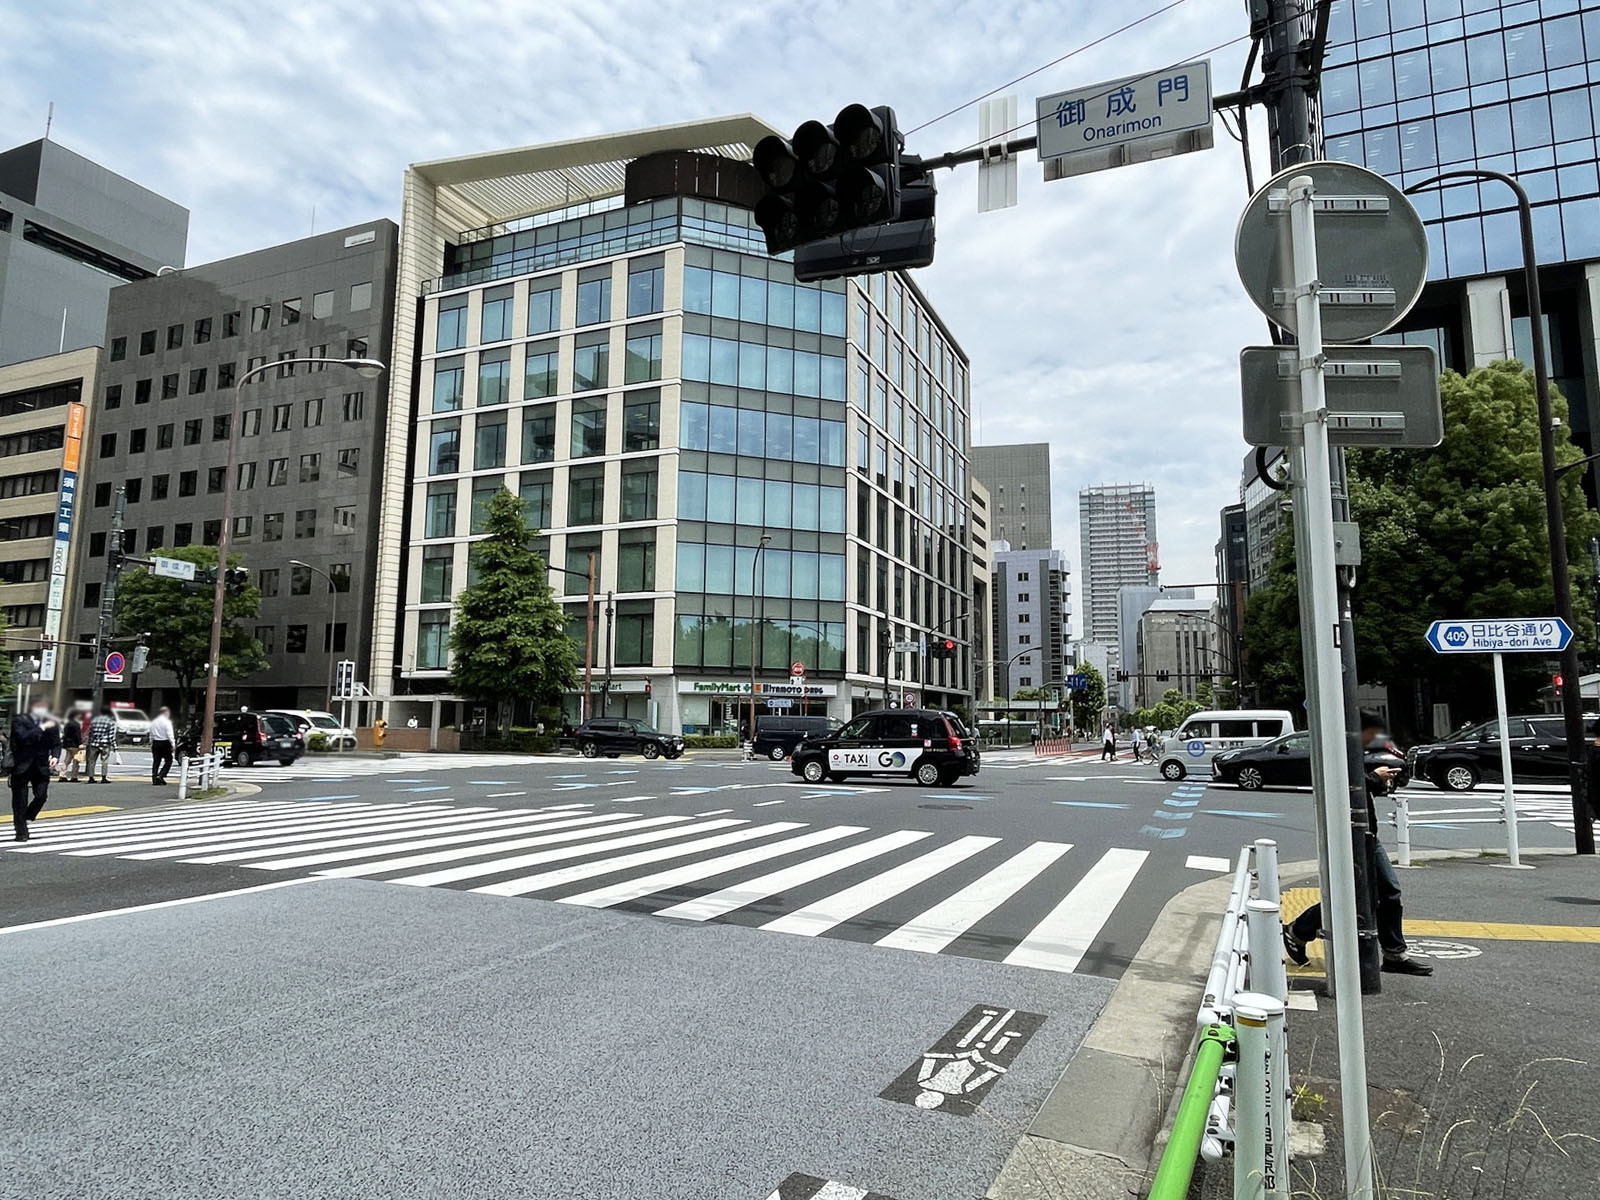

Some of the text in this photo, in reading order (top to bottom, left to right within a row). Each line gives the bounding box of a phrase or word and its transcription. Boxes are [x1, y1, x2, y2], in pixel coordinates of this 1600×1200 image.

[1056, 75, 1189, 128] 御成門
[1083, 115, 1162, 142] Onarimon
[1472, 623, 1553, 637] 日比谷通り
[1446, 632, 1466, 642] 409
[1473, 637, 1552, 648] Hibiya-dori Ave
[694, 682, 741, 693] FamilyMart
[844, 754, 868, 763] TAXI
